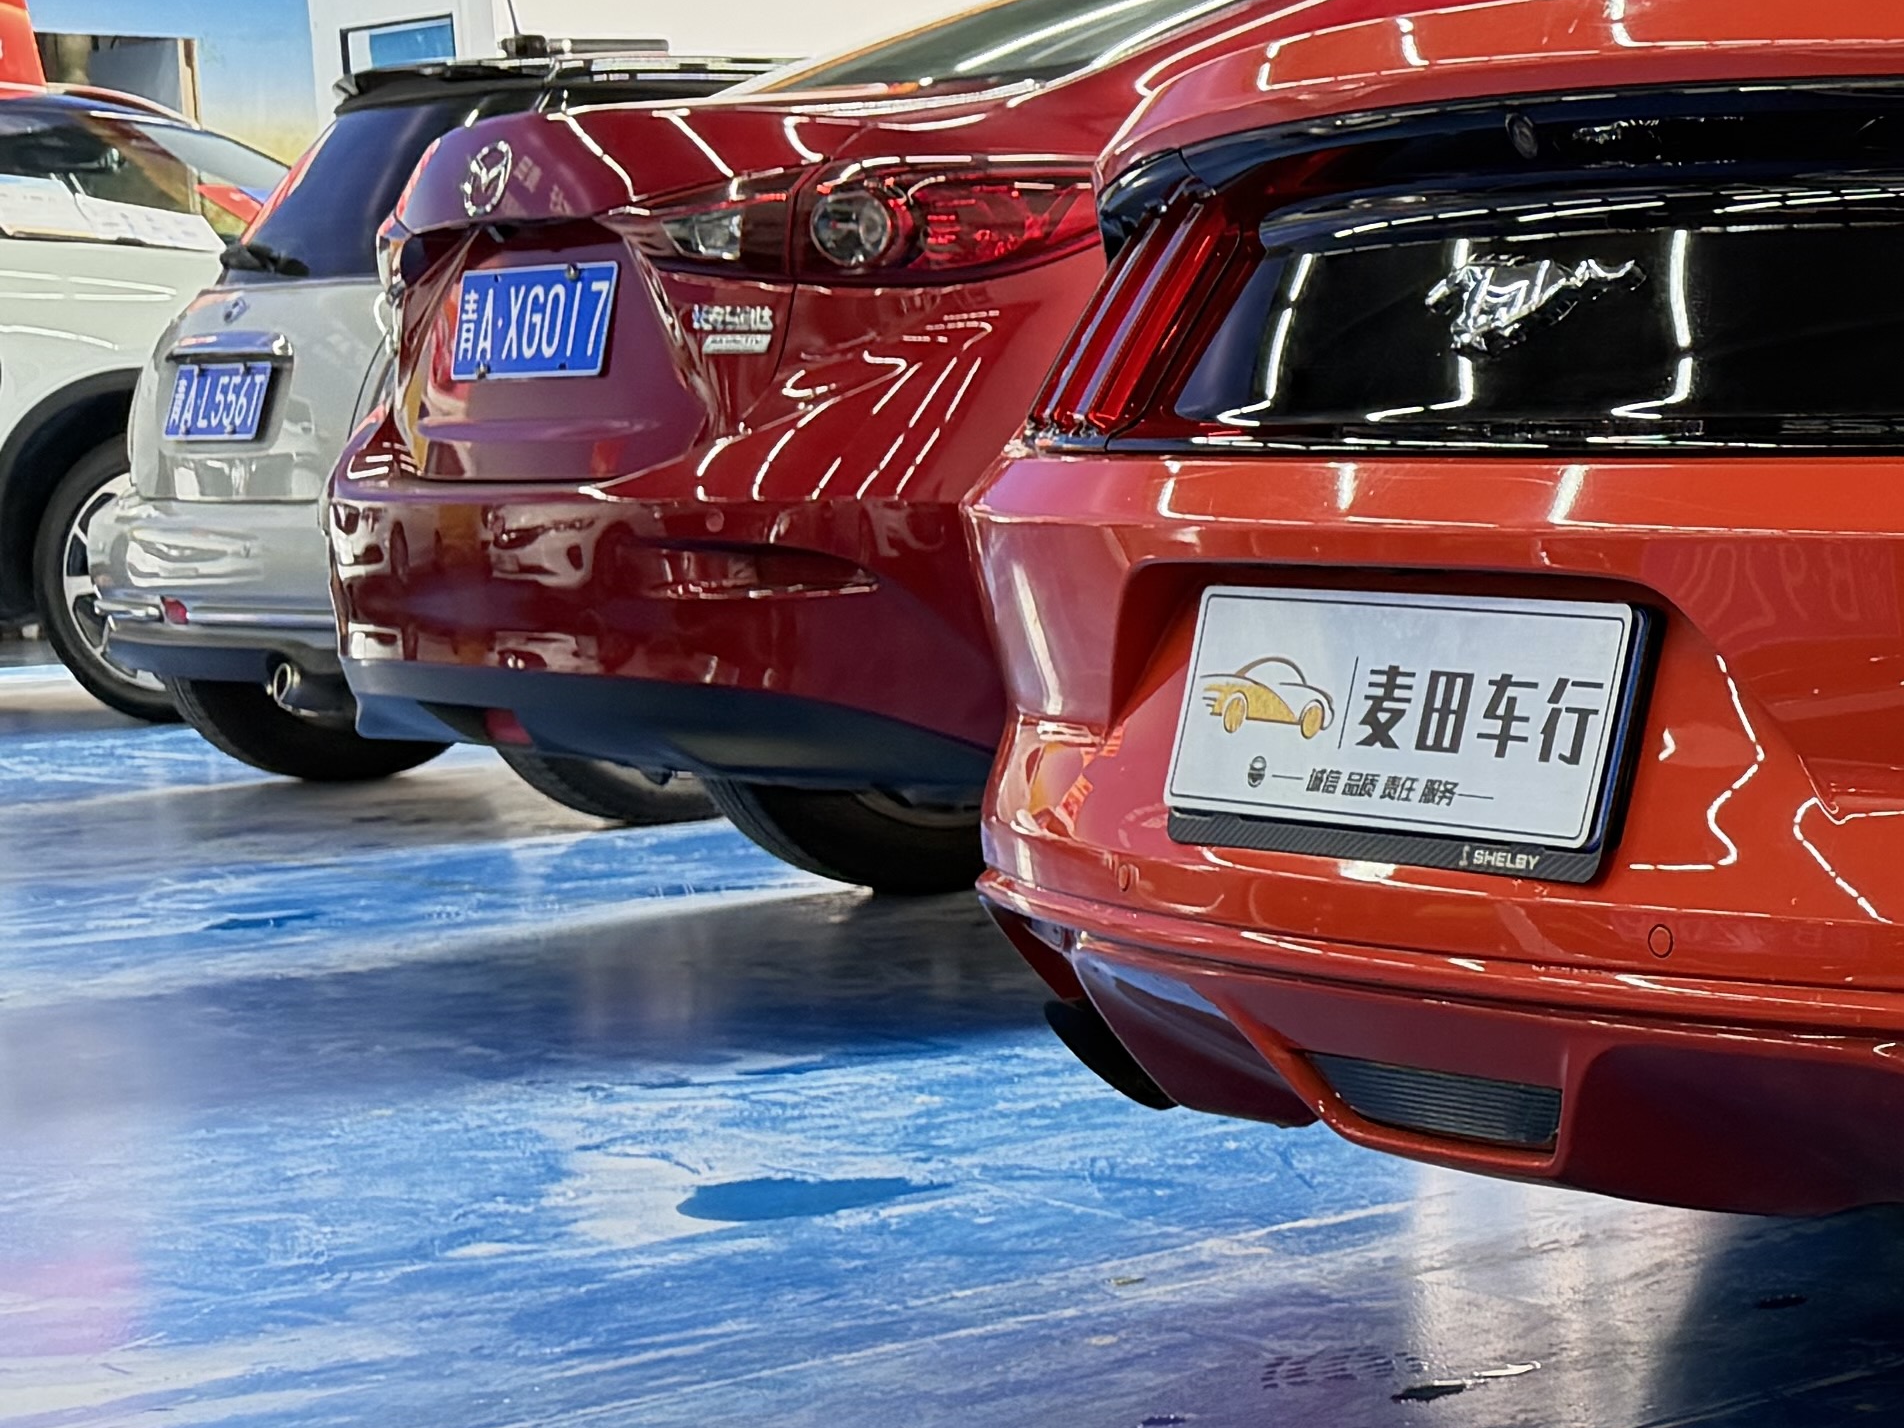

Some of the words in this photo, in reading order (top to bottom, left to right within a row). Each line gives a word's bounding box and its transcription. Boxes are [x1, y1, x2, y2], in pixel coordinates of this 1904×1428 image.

[1355, 665, 1605, 766] 麦田车行
[1305, 767, 1343, 795] 诚信
[1341, 771, 1381, 798] 品质
[1379, 775, 1420, 803] 责任
[1418, 778, 1460, 807] 服务
[1472, 848, 1541, 872] SHELBY
